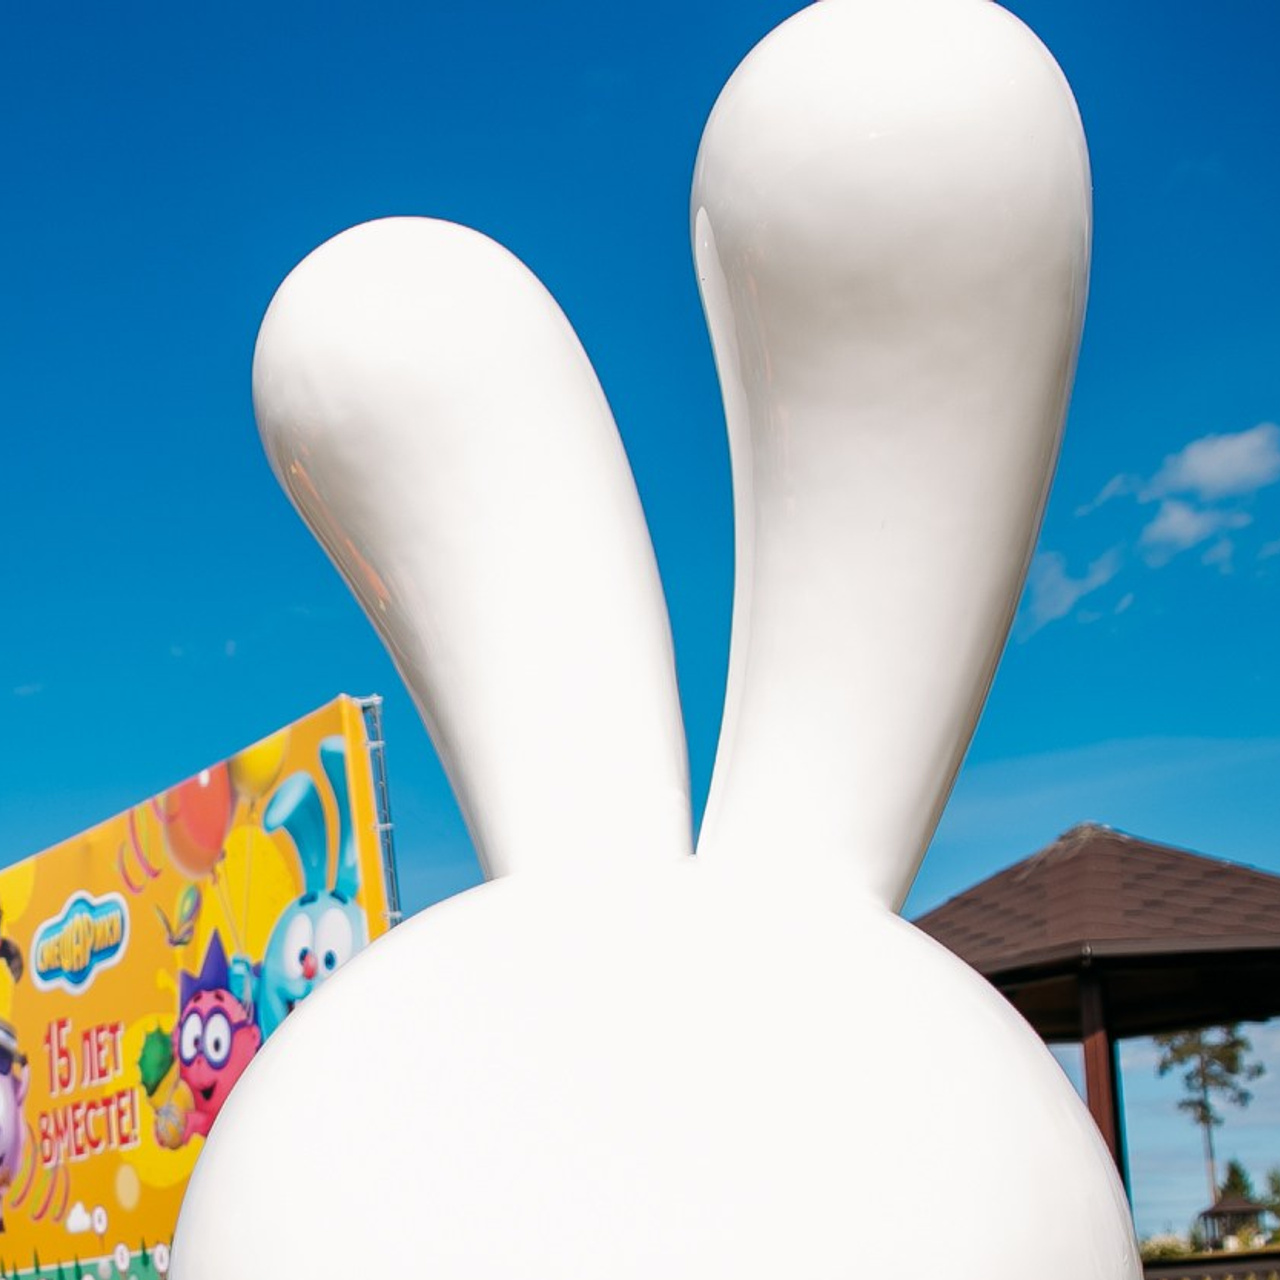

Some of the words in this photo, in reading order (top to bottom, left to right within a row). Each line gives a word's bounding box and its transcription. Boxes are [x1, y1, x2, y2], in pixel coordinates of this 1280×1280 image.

[44, 1017, 75, 1096] 15
[81, 1021, 124, 1087] ЛЕТ
[39, 1088, 140, 1169] ВМЕСТЕ!
